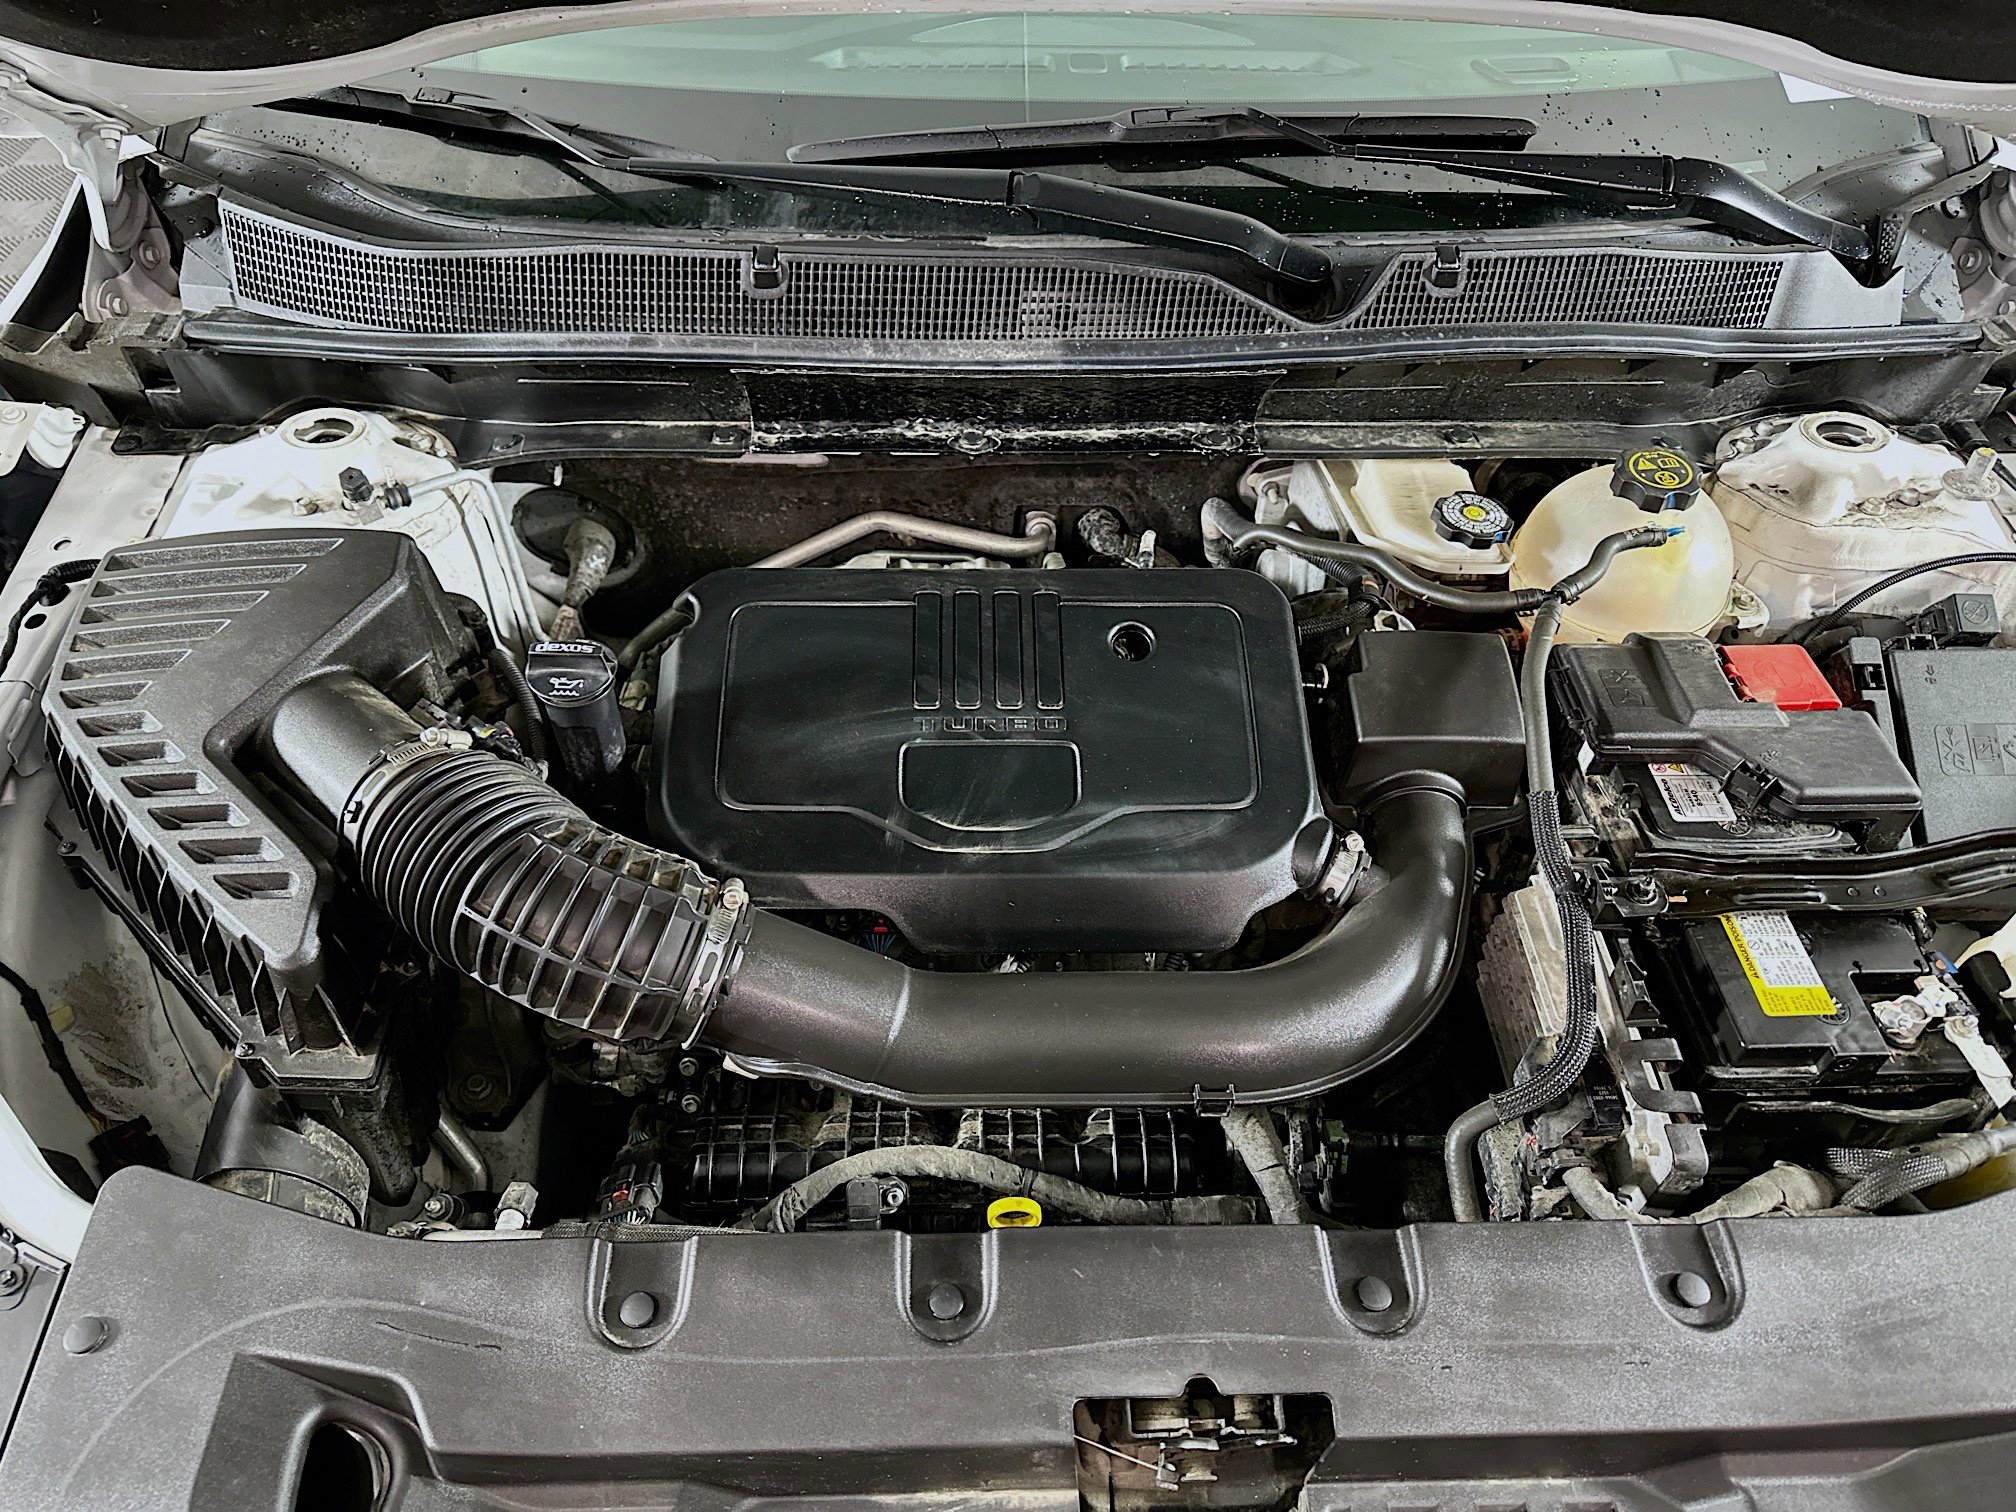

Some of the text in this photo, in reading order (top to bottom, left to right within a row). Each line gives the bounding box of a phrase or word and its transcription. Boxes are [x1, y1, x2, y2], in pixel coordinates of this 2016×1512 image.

[535, 641, 596, 654] dexos
[913, 716, 1067, 733] TURBO
[1661, 778, 1683, 815] ACDelco
[1738, 942, 1756, 972] DANGER
